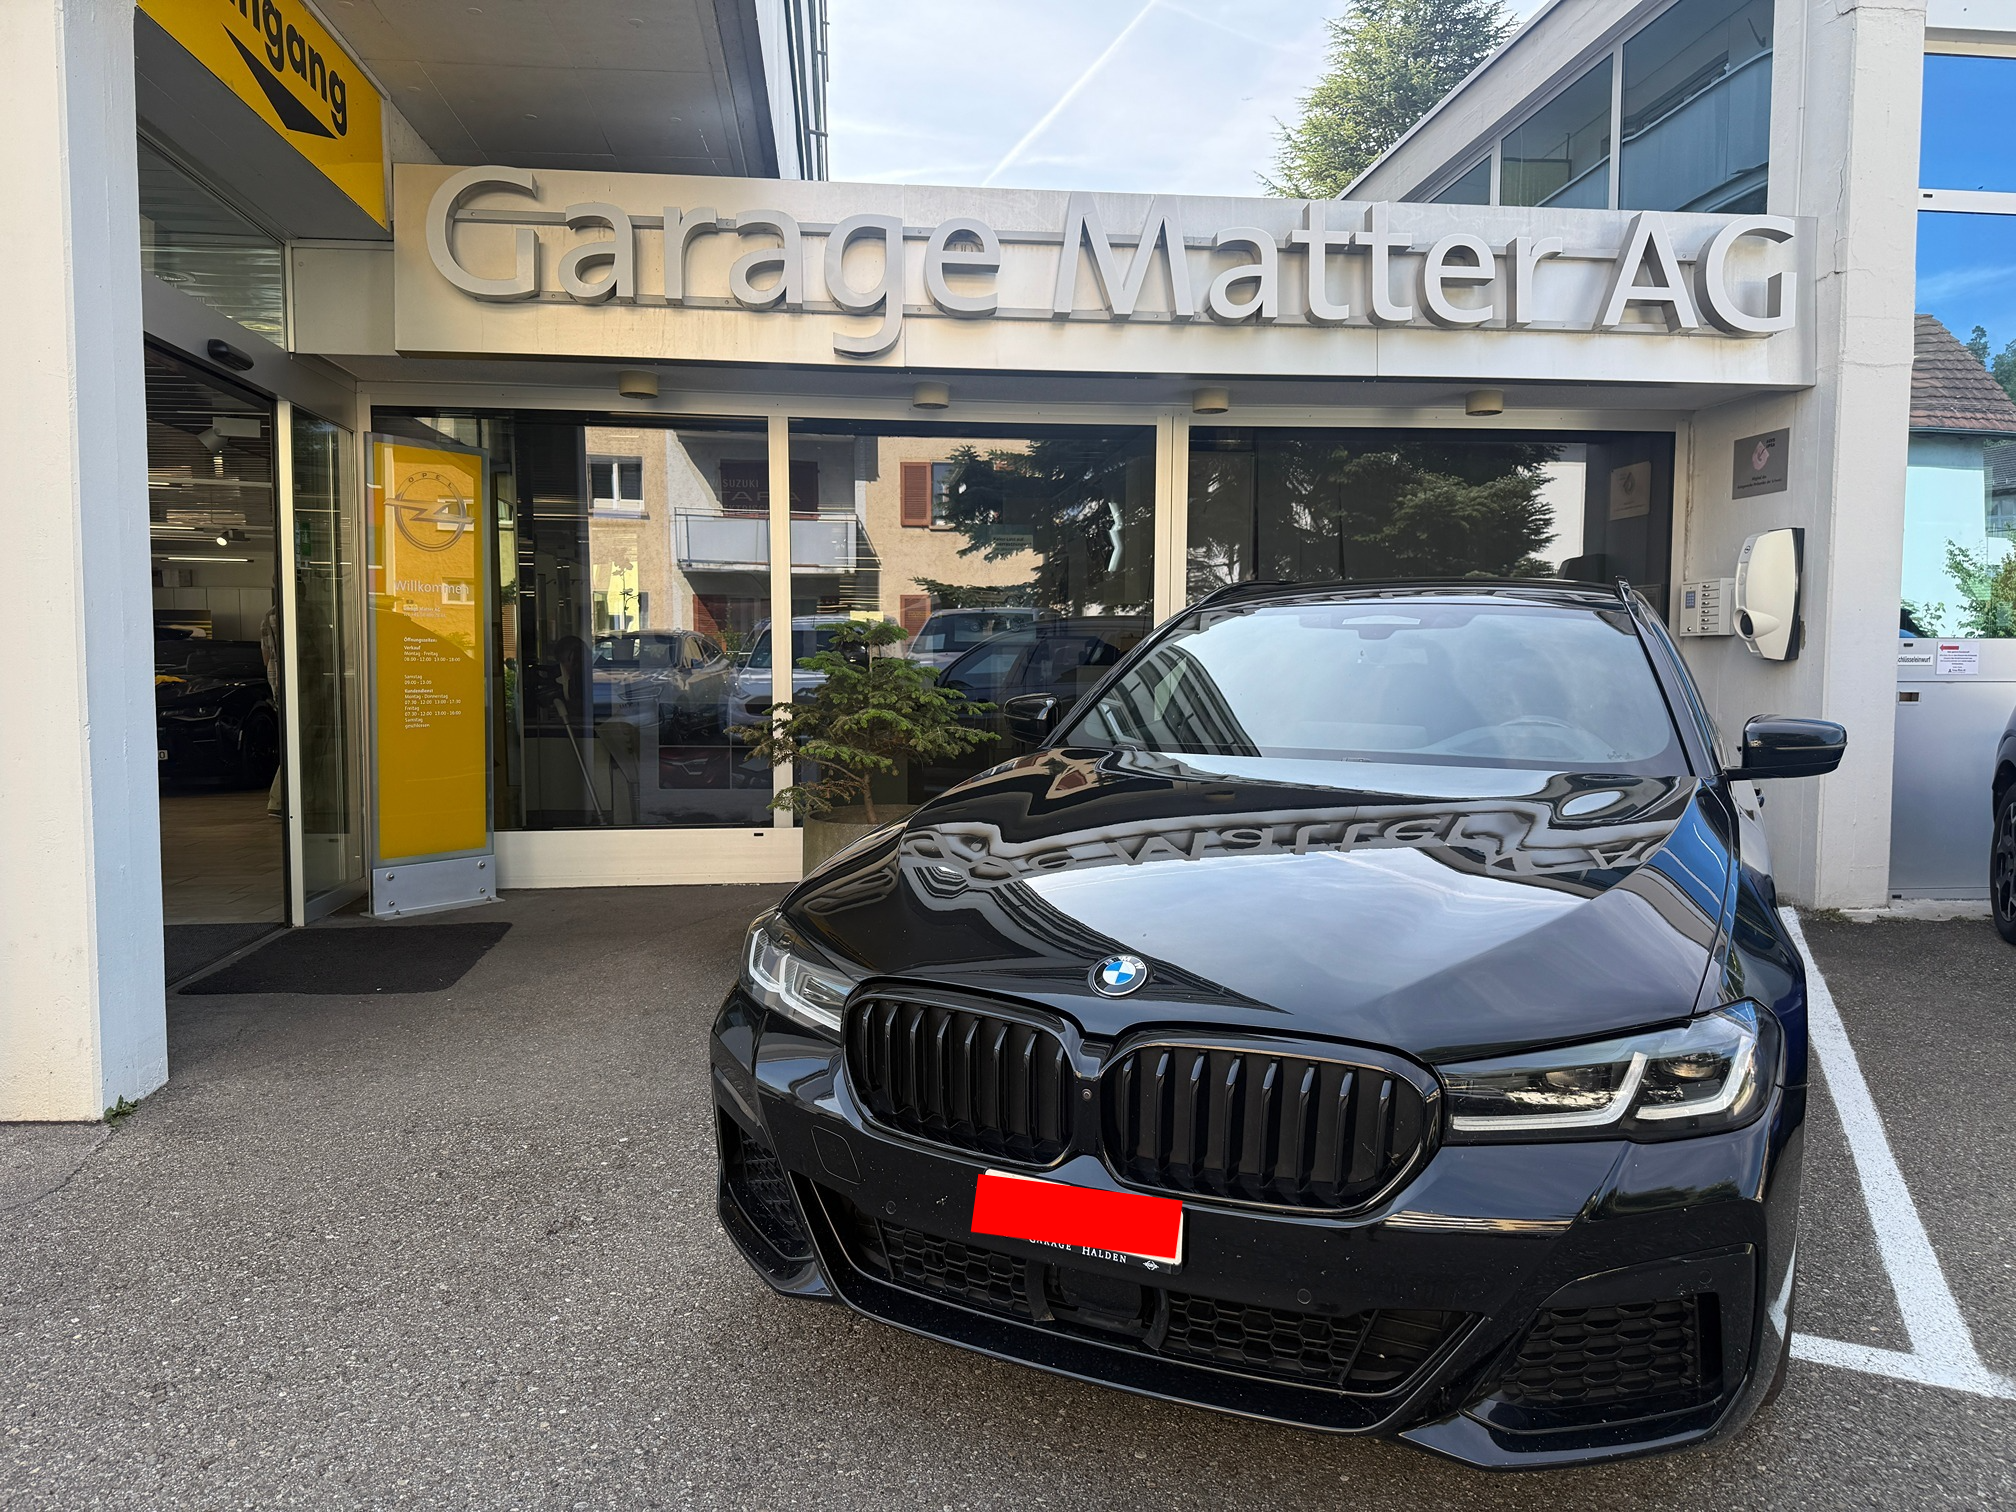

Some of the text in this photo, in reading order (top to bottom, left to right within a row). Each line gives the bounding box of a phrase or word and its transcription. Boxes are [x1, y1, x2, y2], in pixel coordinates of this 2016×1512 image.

[425, 165, 1798, 360] Garage Matter AG
[408, 472, 453, 489] OPEL
[722, 479, 759, 489] SUZUKI
[394, 580, 469, 595] Willkommen
[1105, 956, 1145, 969] BMW
[1081, 1245, 1127, 1264] HALDEN
